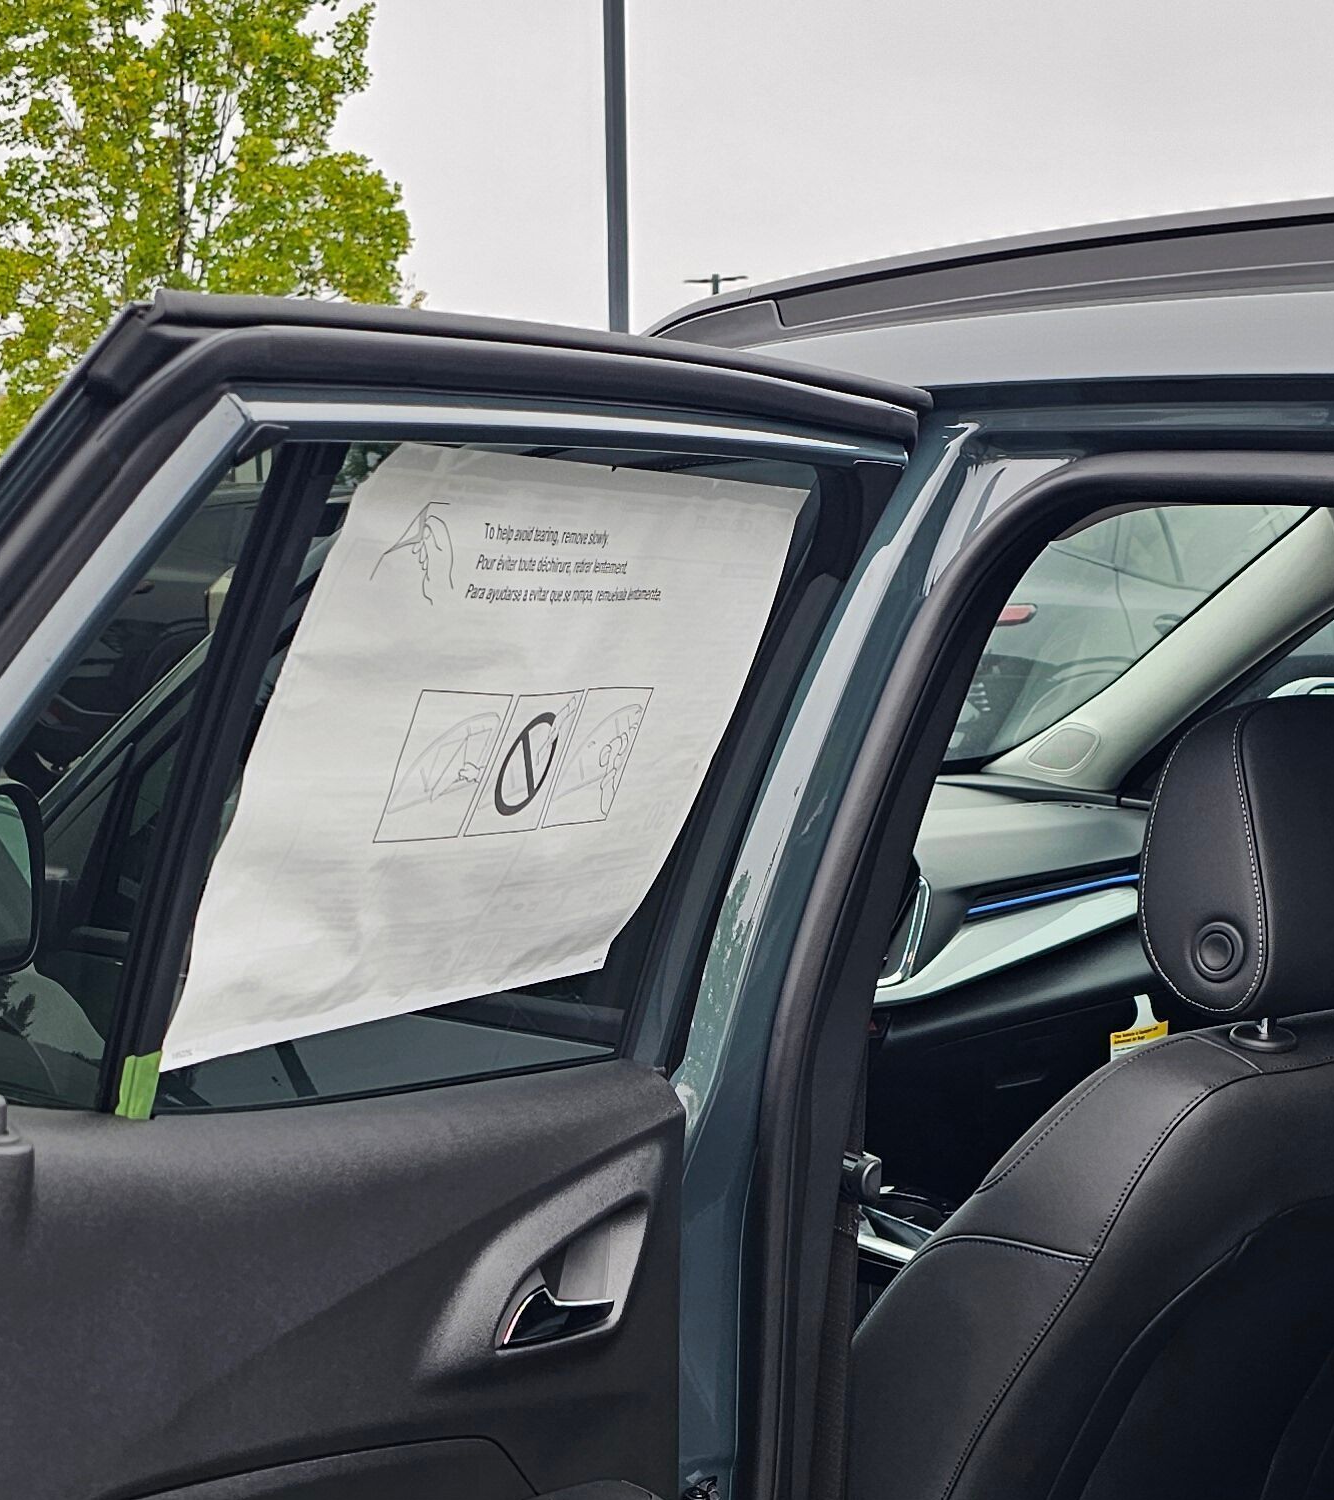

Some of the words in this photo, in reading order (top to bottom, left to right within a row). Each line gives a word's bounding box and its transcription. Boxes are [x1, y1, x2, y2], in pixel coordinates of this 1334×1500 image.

[485, 522, 495, 540] To
[496, 523, 514, 545] help
[514, 526, 535, 542] avoid
[561, 531, 588, 545] remove
[475, 553, 496, 570] Pour
[496, 554, 518, 572] éviter
[518, 557, 536, 572] toute
[465, 583, 486, 599] Para
[486, 585, 522, 604] ayudarse
[522, 589, 529, 602] a
[529, 587, 549, 602] evitar
[549, 590, 563, 605] que
[563, 590, 571, 602] se
